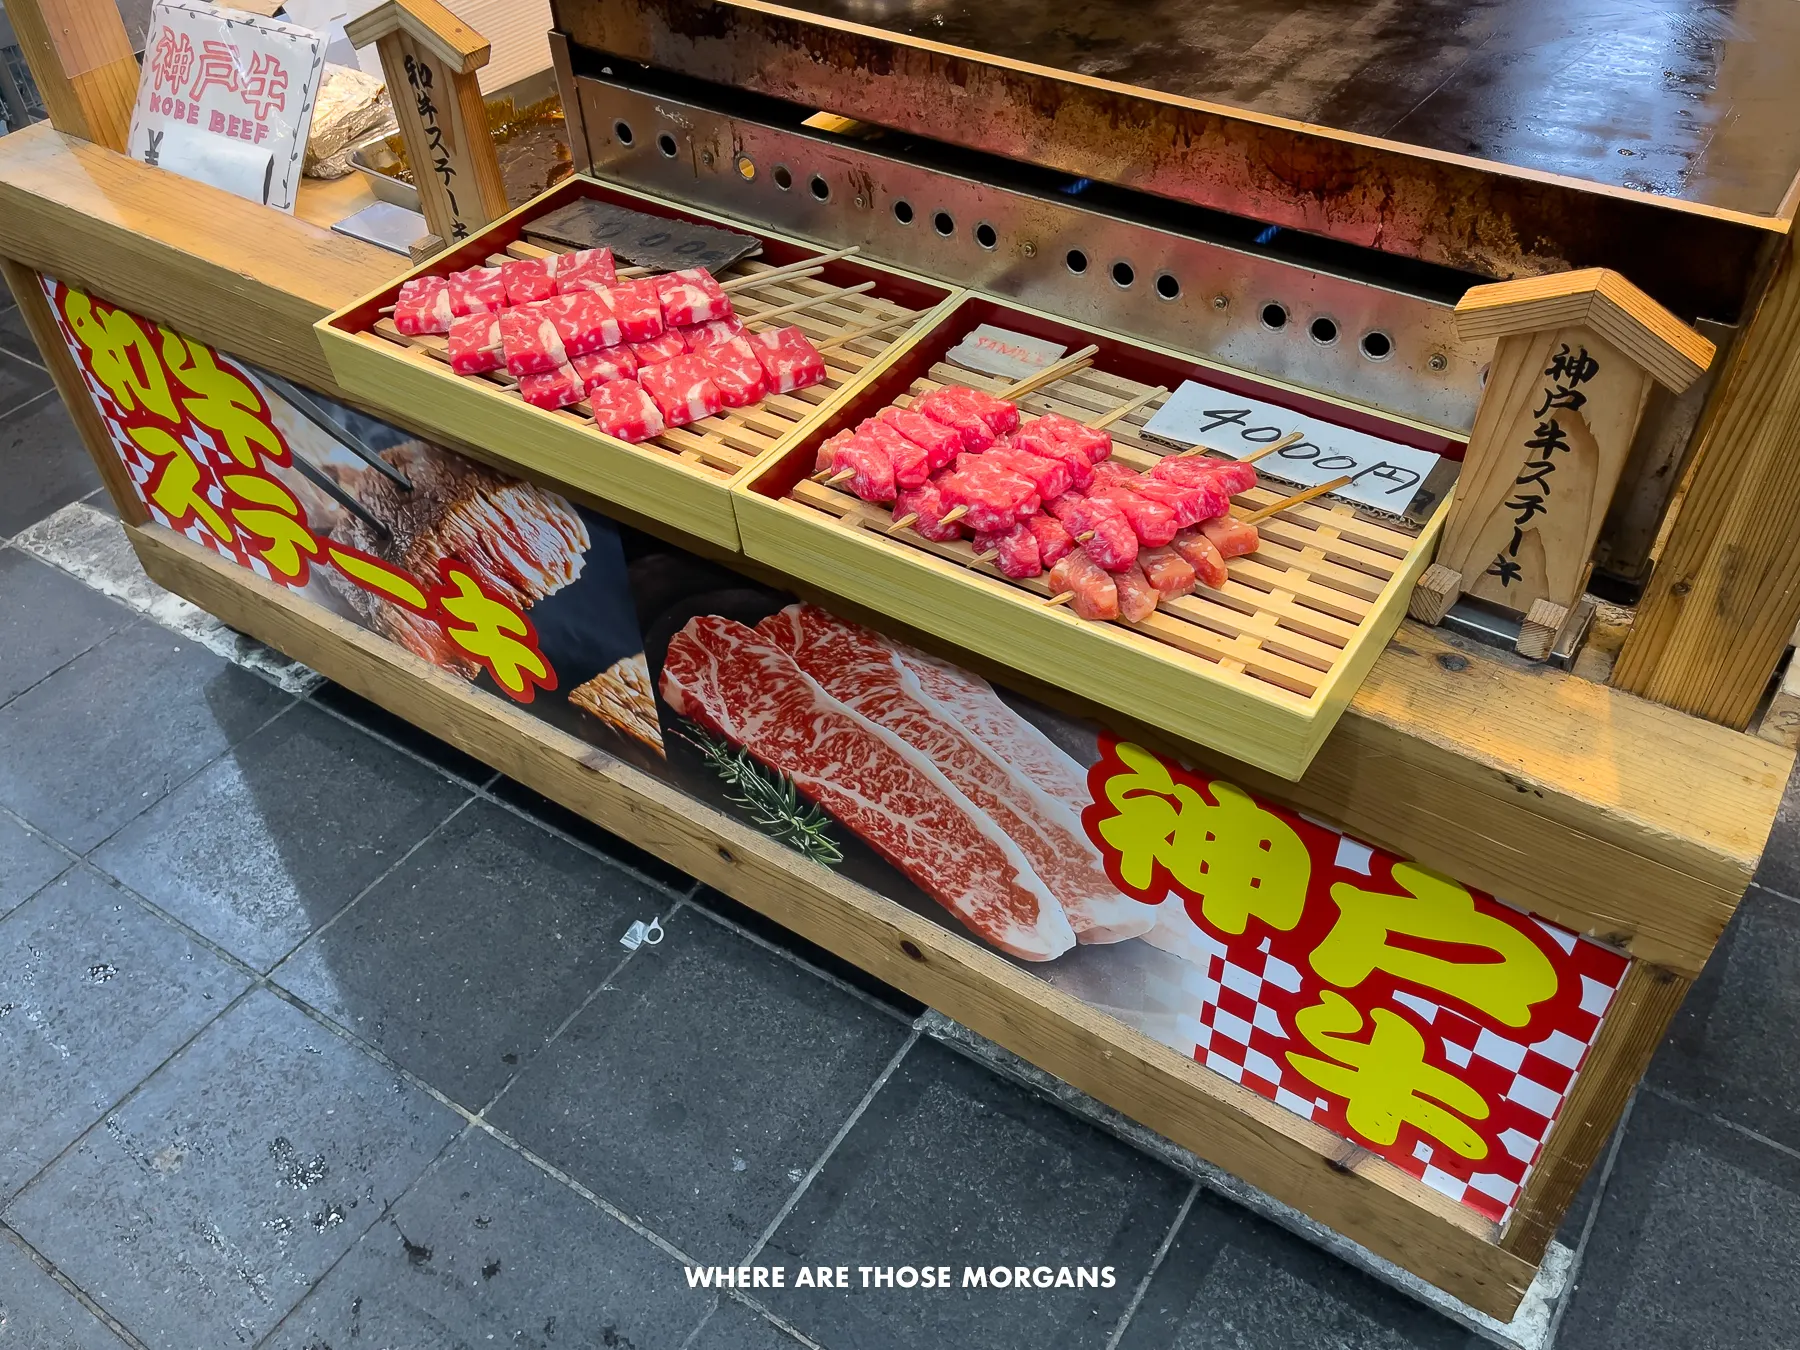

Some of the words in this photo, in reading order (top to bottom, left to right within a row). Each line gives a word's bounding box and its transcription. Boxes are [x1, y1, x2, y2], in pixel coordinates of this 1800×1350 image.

[149, 92, 200, 125] KOBE
[208, 110, 270, 144] BEEF
[152, 25, 288, 121] 神戸牛
[1199, 408, 1421, 495] 4000円
[1486, 343, 1600, 588] 神戸牛ステーキ
